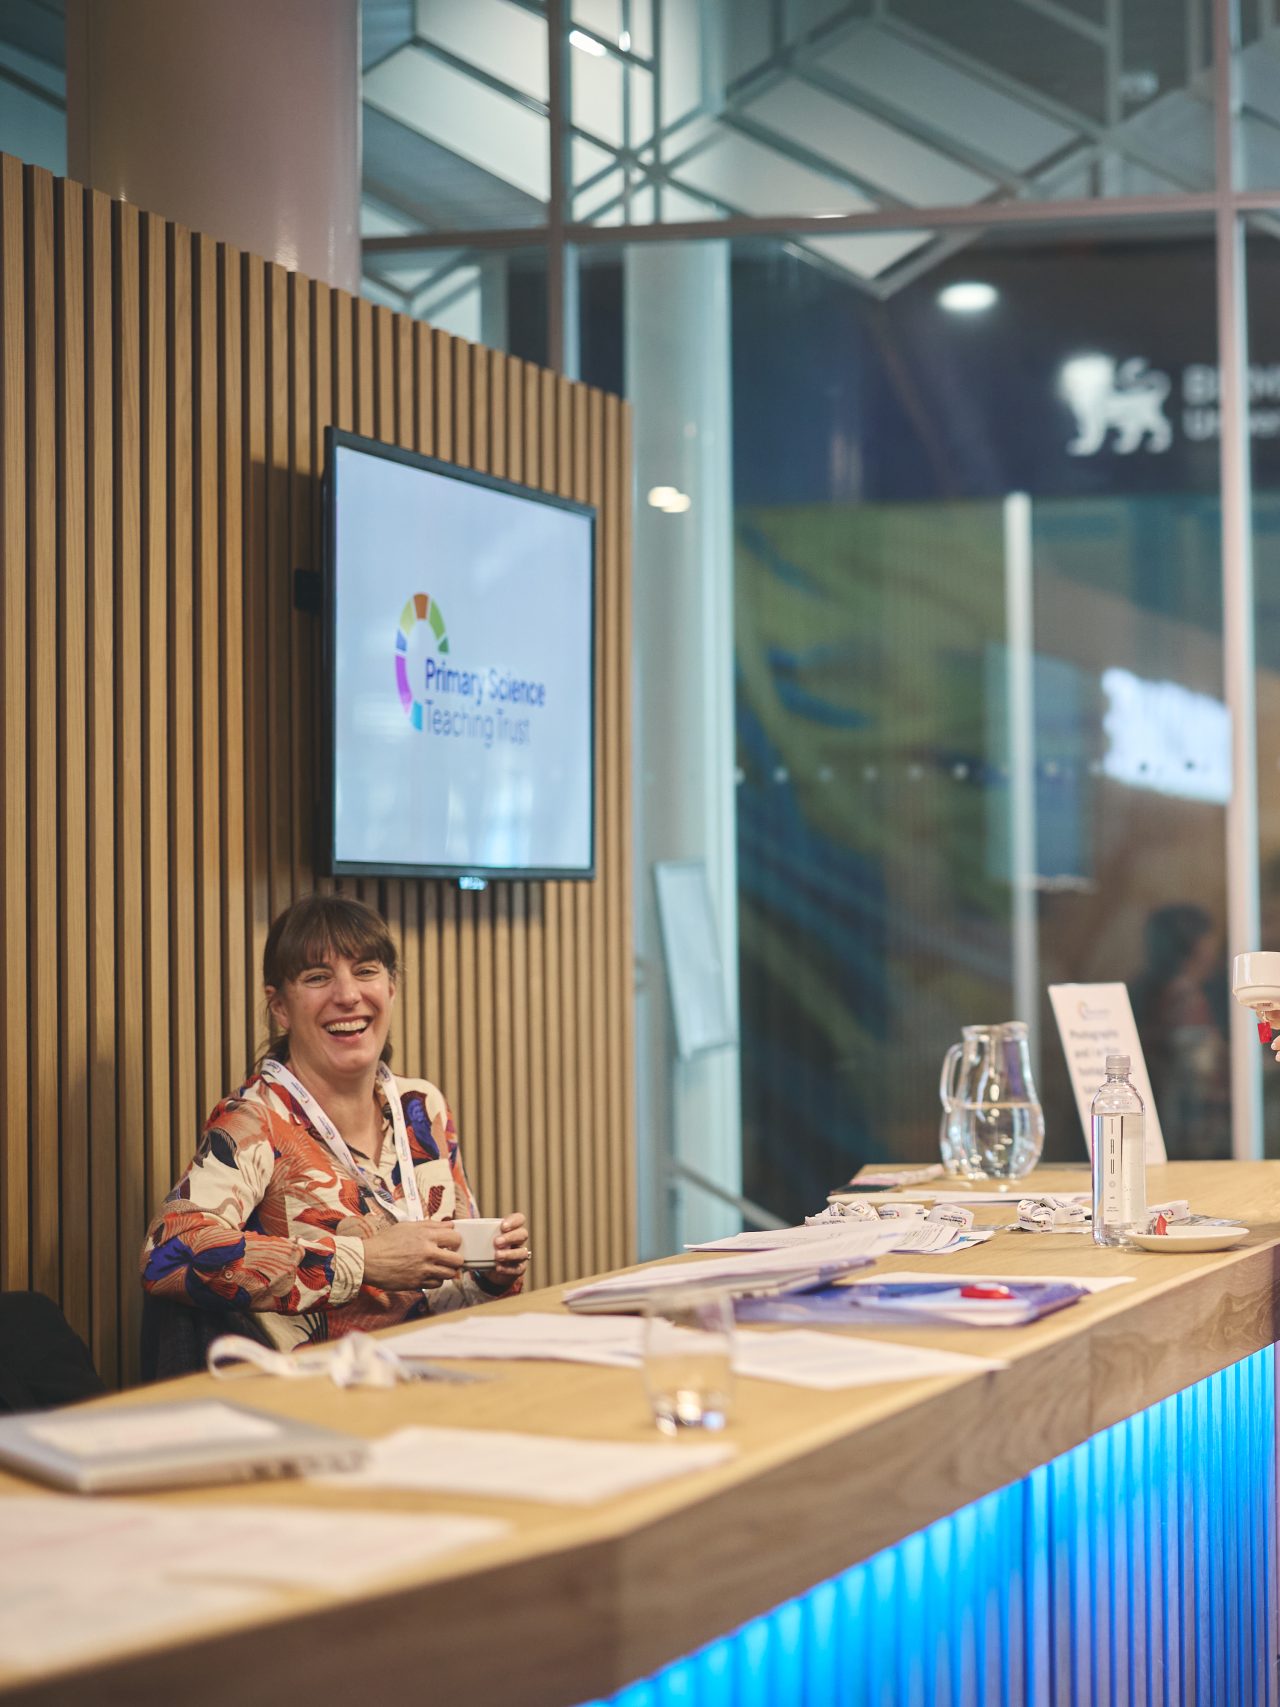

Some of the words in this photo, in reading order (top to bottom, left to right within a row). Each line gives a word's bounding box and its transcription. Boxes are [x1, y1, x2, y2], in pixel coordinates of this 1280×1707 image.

[425, 657, 484, 706] Primary
[489, 667, 546, 707] Science
[424, 698, 494, 749] Teaching
